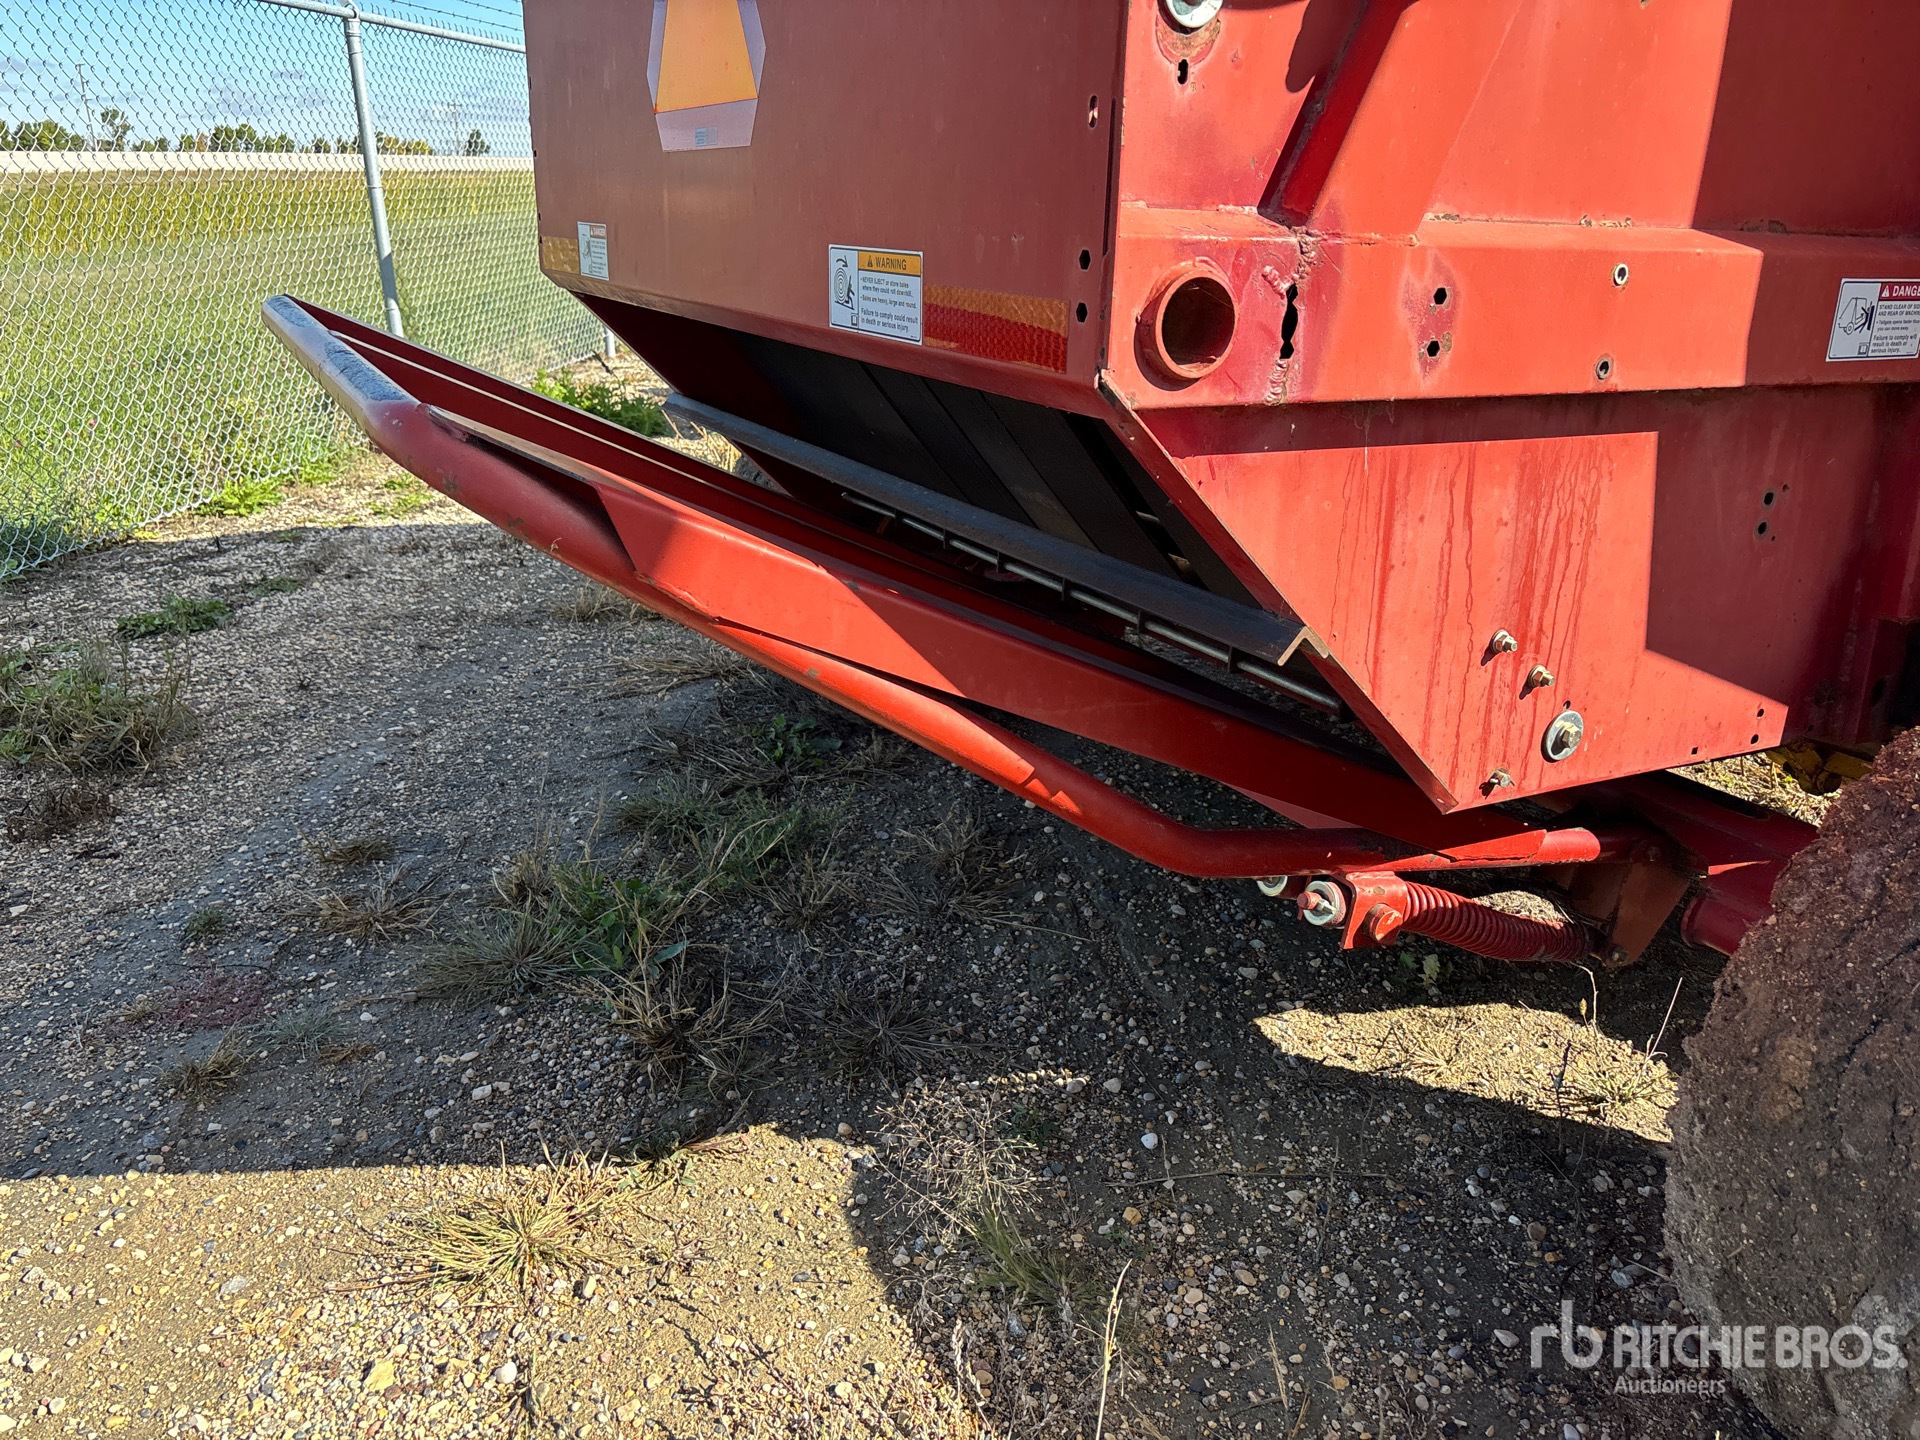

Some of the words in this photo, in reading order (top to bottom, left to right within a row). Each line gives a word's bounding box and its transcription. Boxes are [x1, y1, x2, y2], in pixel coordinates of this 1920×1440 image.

[876, 257, 907, 270] WARNING
[861, 308, 874, 316] Failure
[880, 311, 893, 321] comply
[866, 317, 876, 326] death
[882, 320, 897, 328] serious
